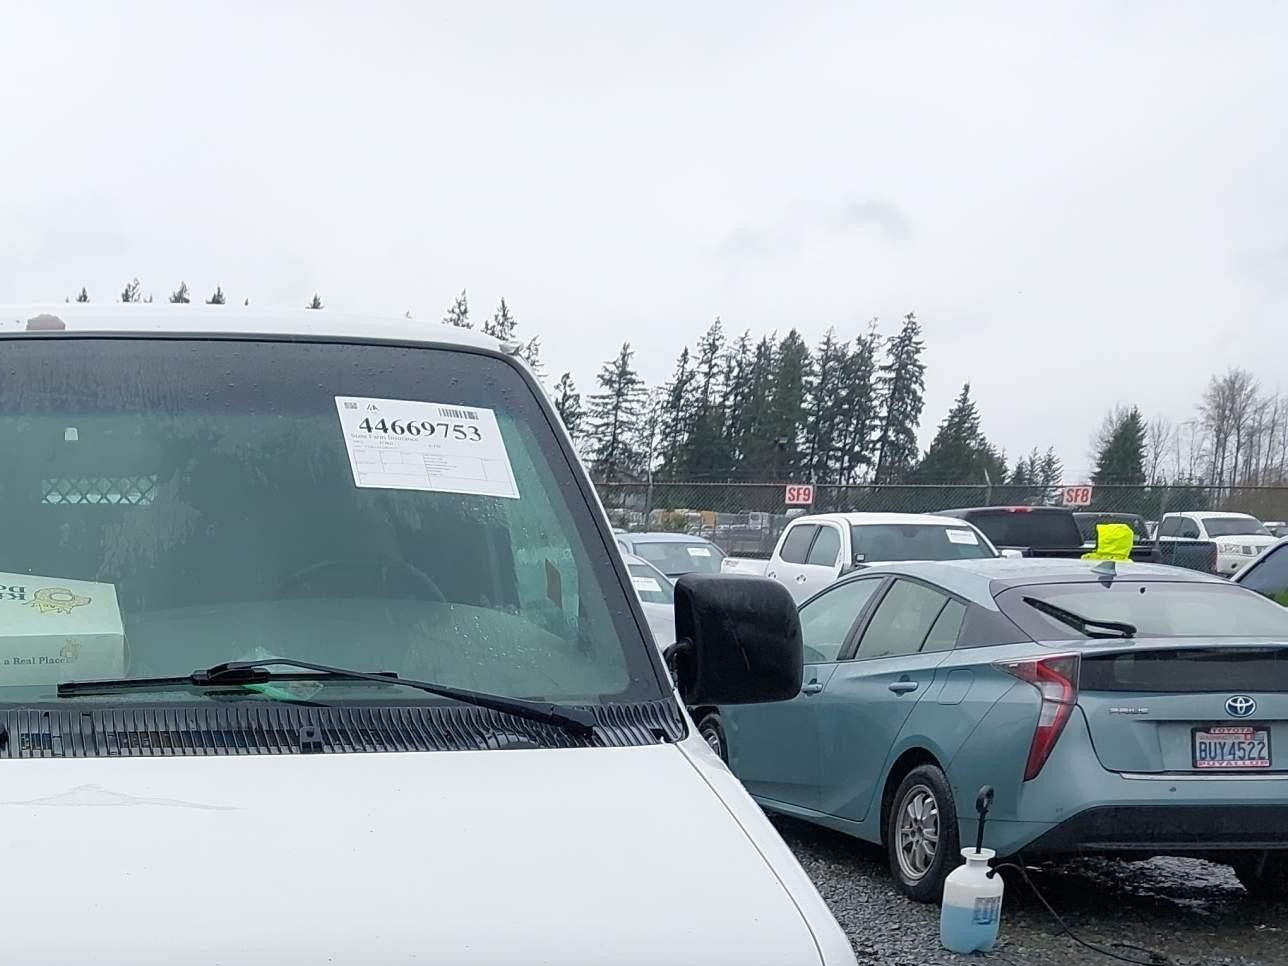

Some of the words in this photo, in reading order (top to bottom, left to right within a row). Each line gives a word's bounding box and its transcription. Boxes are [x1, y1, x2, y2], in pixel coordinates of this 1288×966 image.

[358, 417, 482, 442] 44669753
[788, 486, 811, 502] SF9
[1066, 487, 1090, 503] SF8
[13, 656, 37, 665] Real
[1199, 741, 1266, 761] BUY4522
